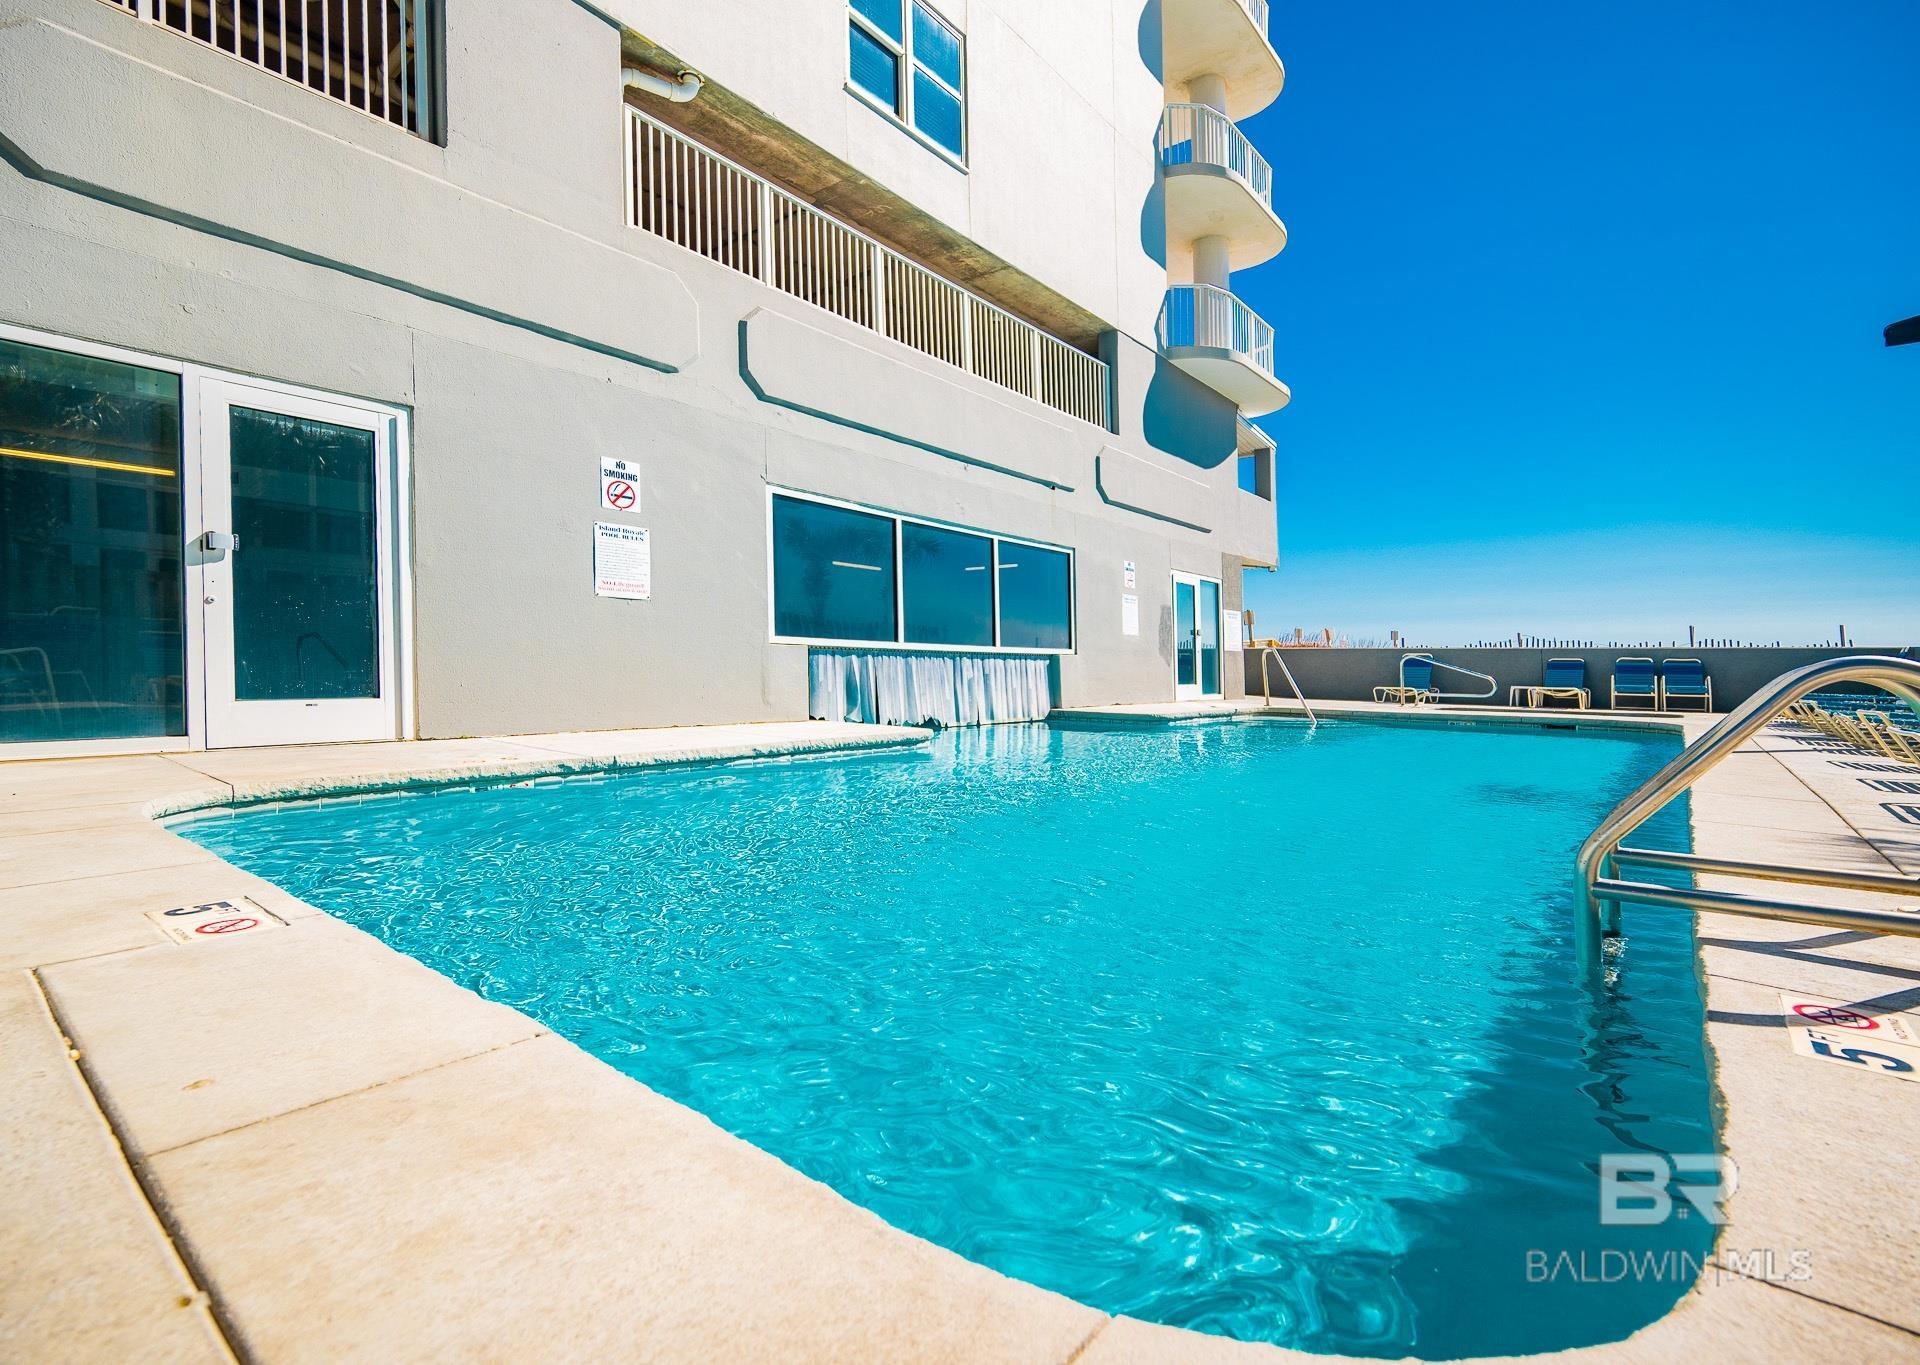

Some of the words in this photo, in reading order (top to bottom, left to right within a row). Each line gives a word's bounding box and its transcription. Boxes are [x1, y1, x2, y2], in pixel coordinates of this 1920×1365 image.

[615, 460, 626, 471] NO
[603, 468, 638, 483] SMOKING
[599, 525, 621, 533] Island
[163, 901, 233, 917] 5
[1810, 1040, 1915, 1073] 5
